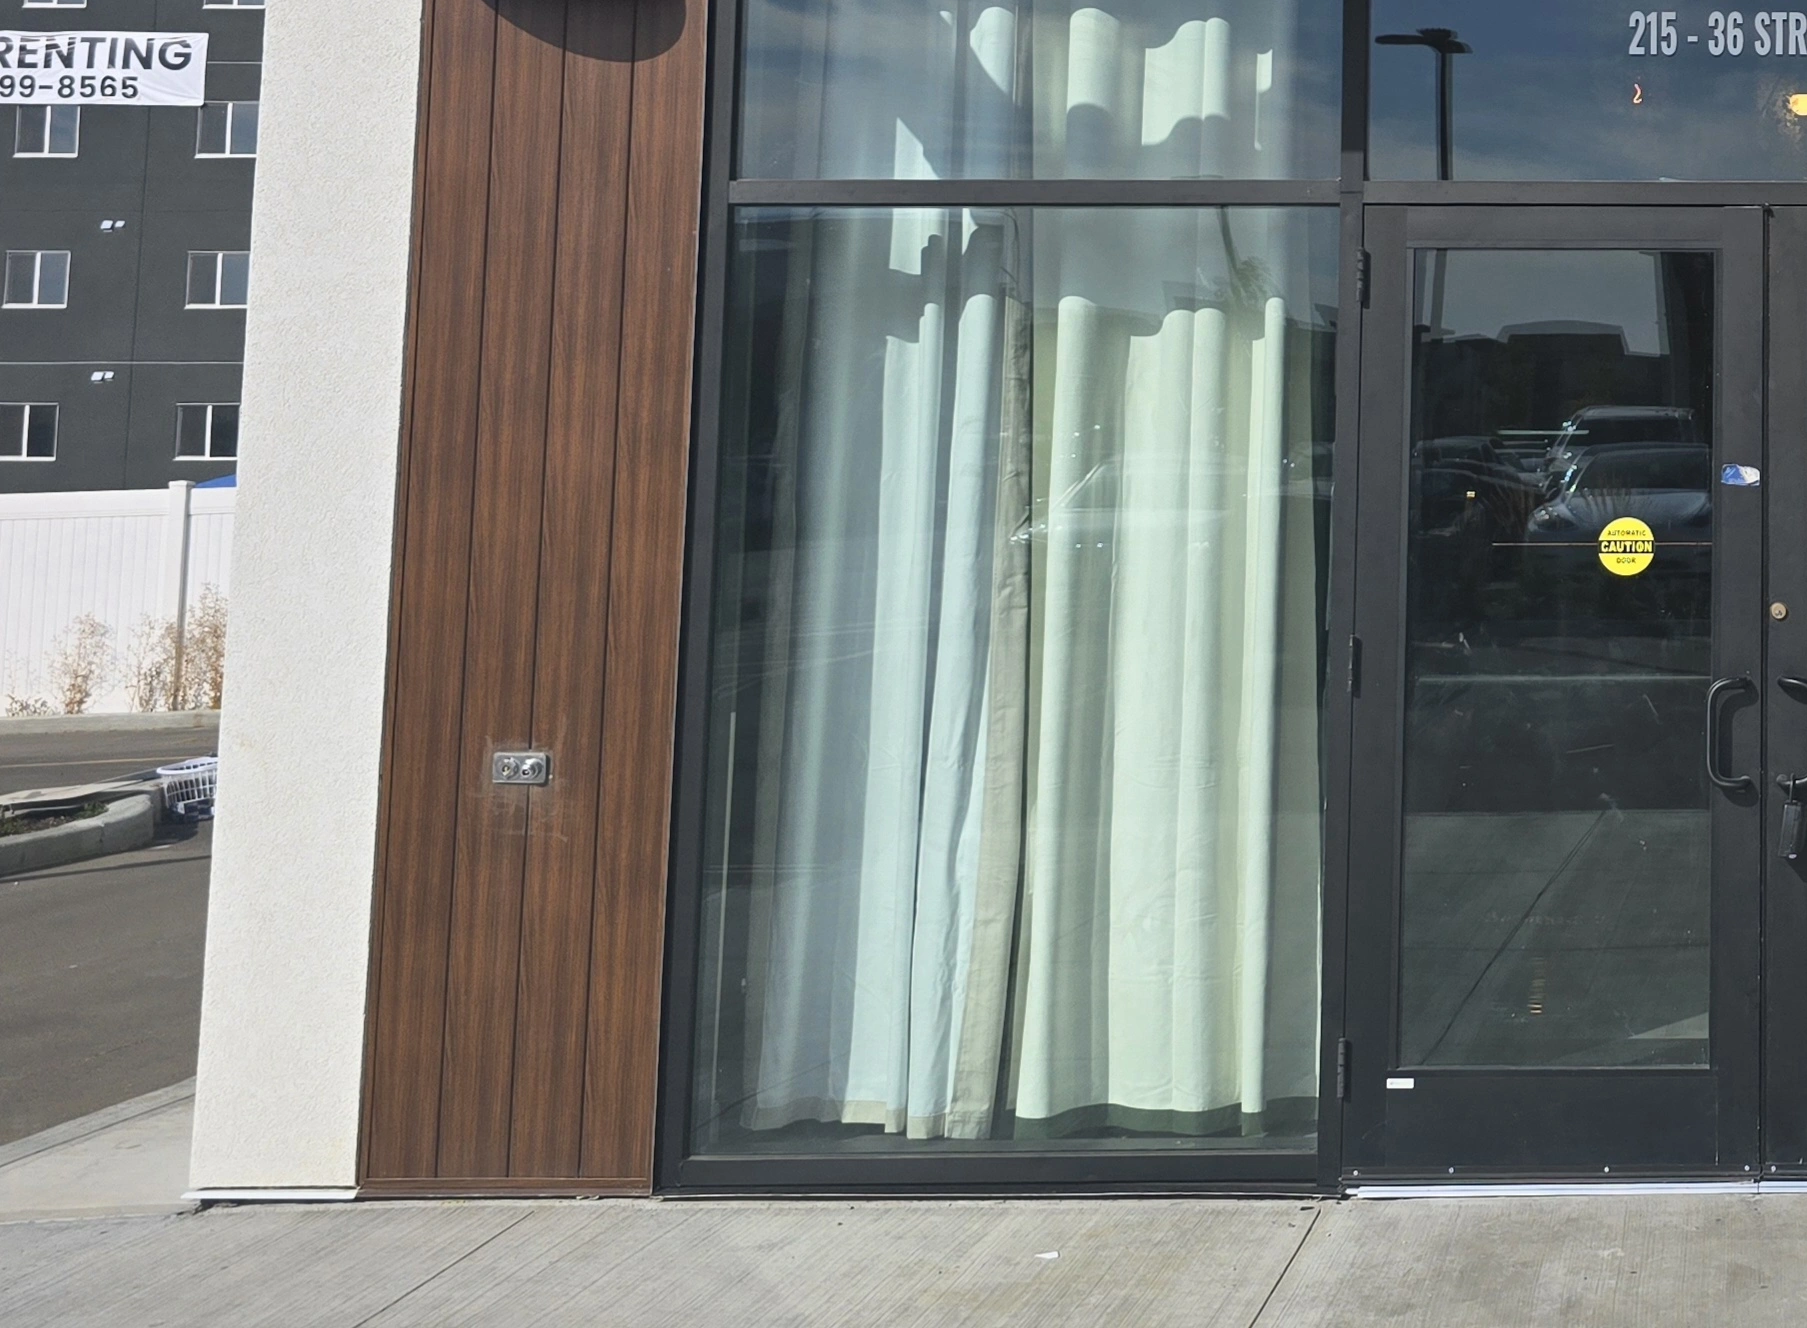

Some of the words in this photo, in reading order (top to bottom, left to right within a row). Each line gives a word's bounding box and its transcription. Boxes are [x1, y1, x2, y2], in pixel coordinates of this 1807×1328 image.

[1628, 10, 1678, 55] 215
[1708, 10, 1744, 55] 36
[0, 36, 192, 71] RENTING
[1607, 529, 1647, 537] AUTOMATIC
[1600, 541, 1653, 553] CAUTION
